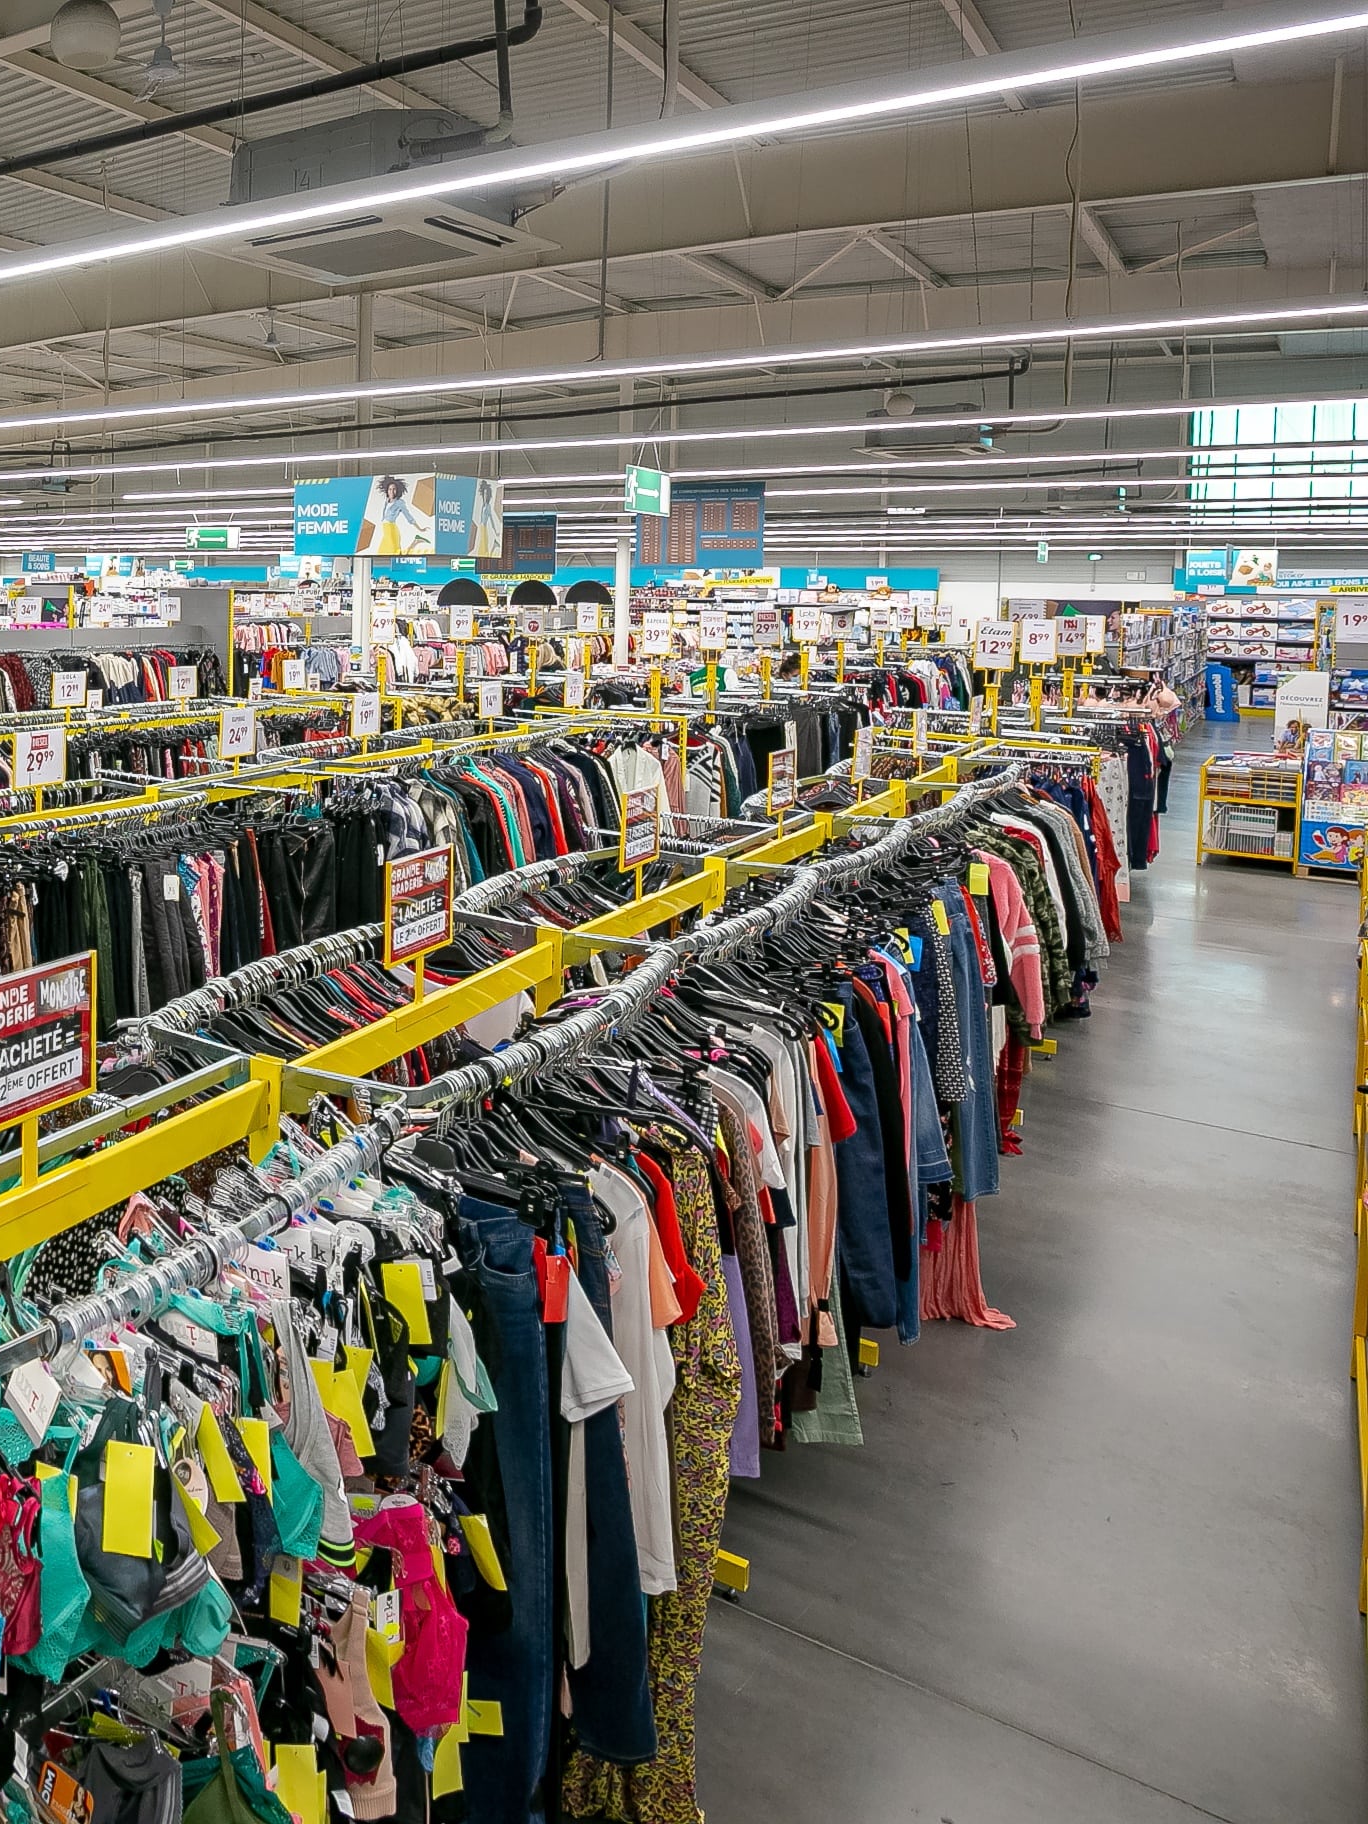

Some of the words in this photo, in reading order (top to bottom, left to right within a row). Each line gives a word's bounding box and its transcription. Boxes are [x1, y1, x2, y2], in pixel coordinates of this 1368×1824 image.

[297, 503, 338, 517] MODE
[438, 501, 461, 516] MODE
[297, 520, 348, 535] FEMME
[438, 518, 465, 534] FEMME
[35, 562, 50, 570] SOINS
[1291, 579, 1312, 587] AIME
[1315, 578, 1332, 586] LES
[1334, 578, 1359, 586] BONS
[455, 618, 469, 629] 999
[755, 622, 779, 634] 2999
[797, 620, 819, 631] 1999
[645, 629, 670, 641] 3999
[703, 626, 726, 637] 1499
[980, 626, 1013, 636] Etam
[1057, 632, 1085, 644] 1499
[1028, 633, 1050, 644] 899
[980, 640, 1013, 654] 1299
[61, 683, 79, 698] 1299
[1213, 673, 1226, 714] playmobil
[1280, 694, 1324, 703] DÉCOUVREZ
[359, 709, 374, 725] 1999
[228, 726, 248, 745] 2499
[26, 750, 54, 772] 2999
[398, 907, 403, 922] 1
[404, 891, 436, 921] ACHETÉ
[395, 932, 404, 945] LE
[39, 969, 86, 1010] MONSTRE
[40, 1767, 56, 1805] DIM
